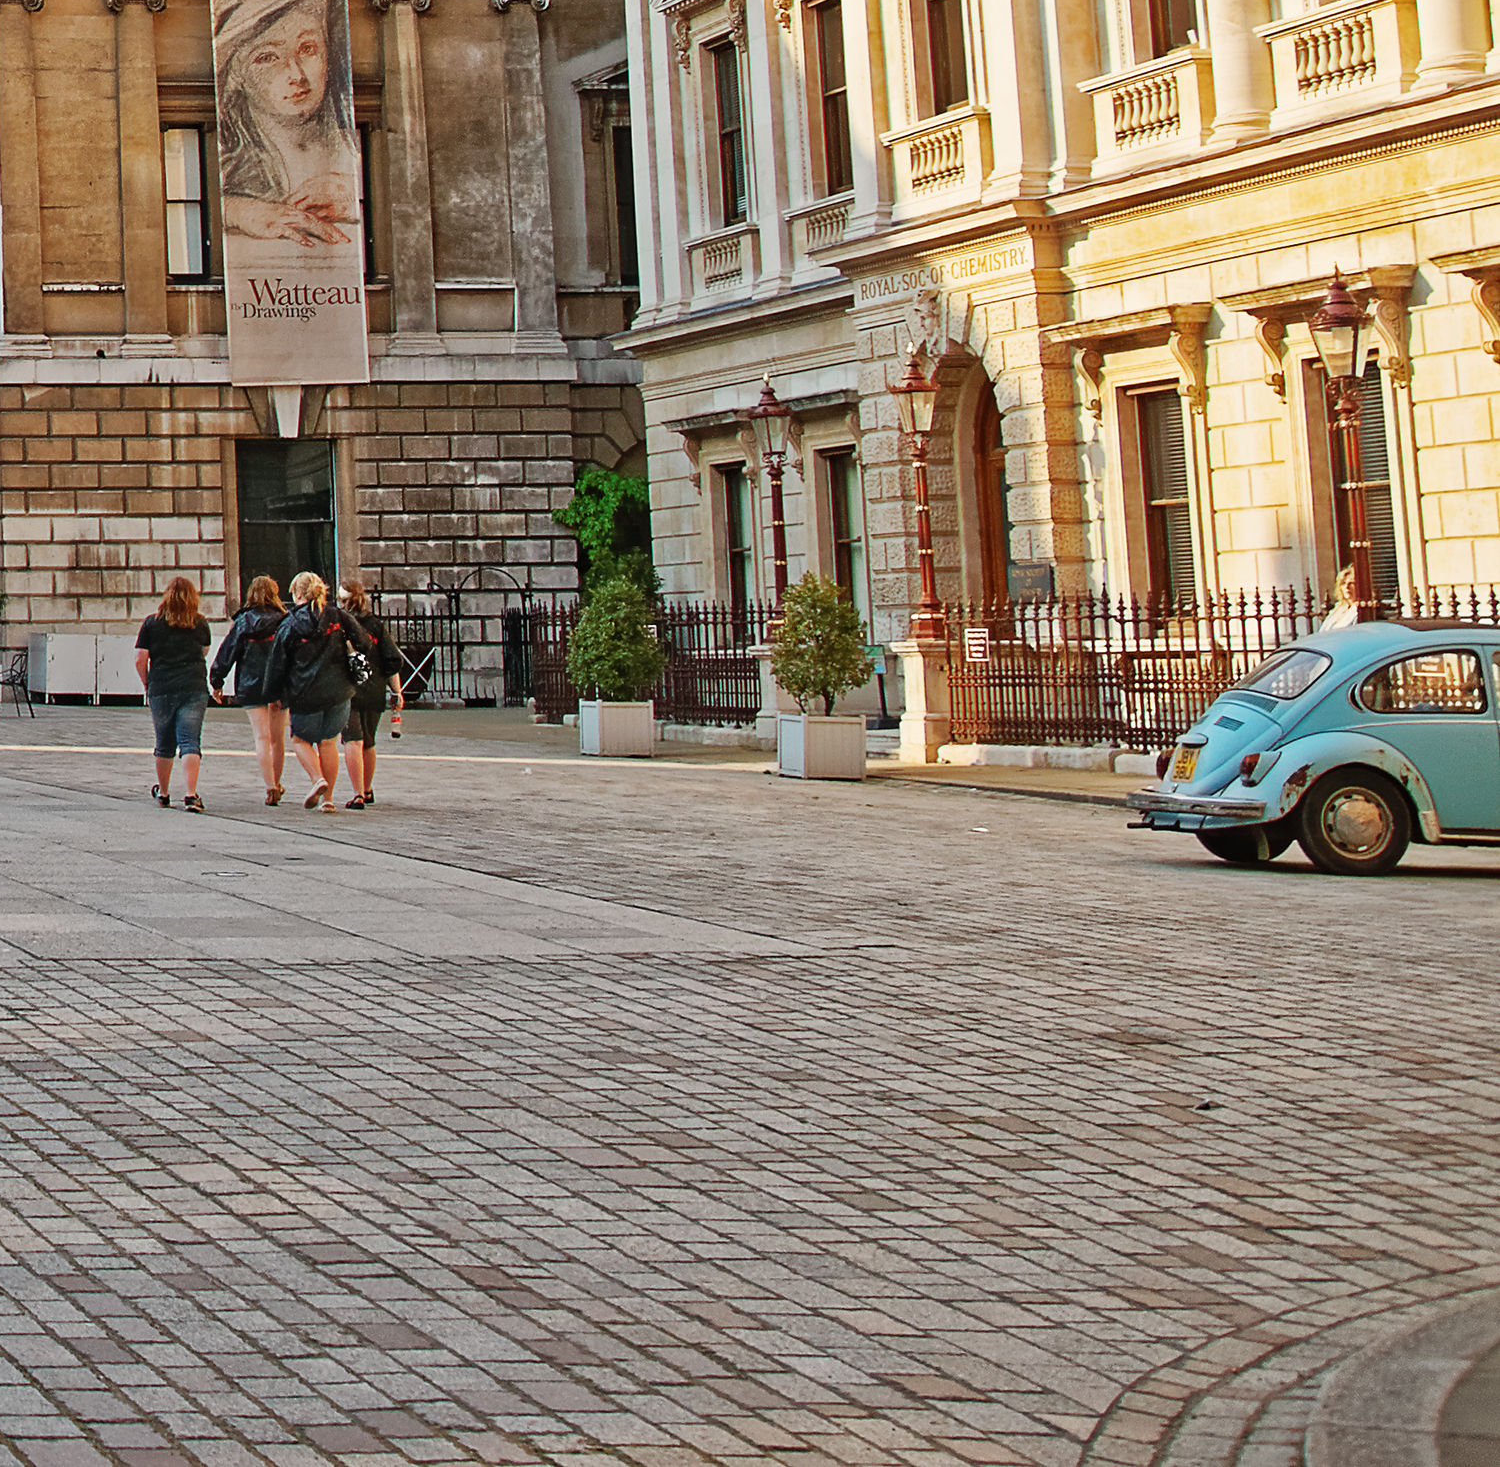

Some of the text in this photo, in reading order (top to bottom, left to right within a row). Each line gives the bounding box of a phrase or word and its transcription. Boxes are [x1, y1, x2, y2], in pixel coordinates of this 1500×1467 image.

[248, 278, 362, 306] Watteau
[861, 278, 899, 301] ROYAL
[902, 269, 927, 292] SOC
[930, 264, 945, 285] OF
[242, 303, 317, 322] Drawings
